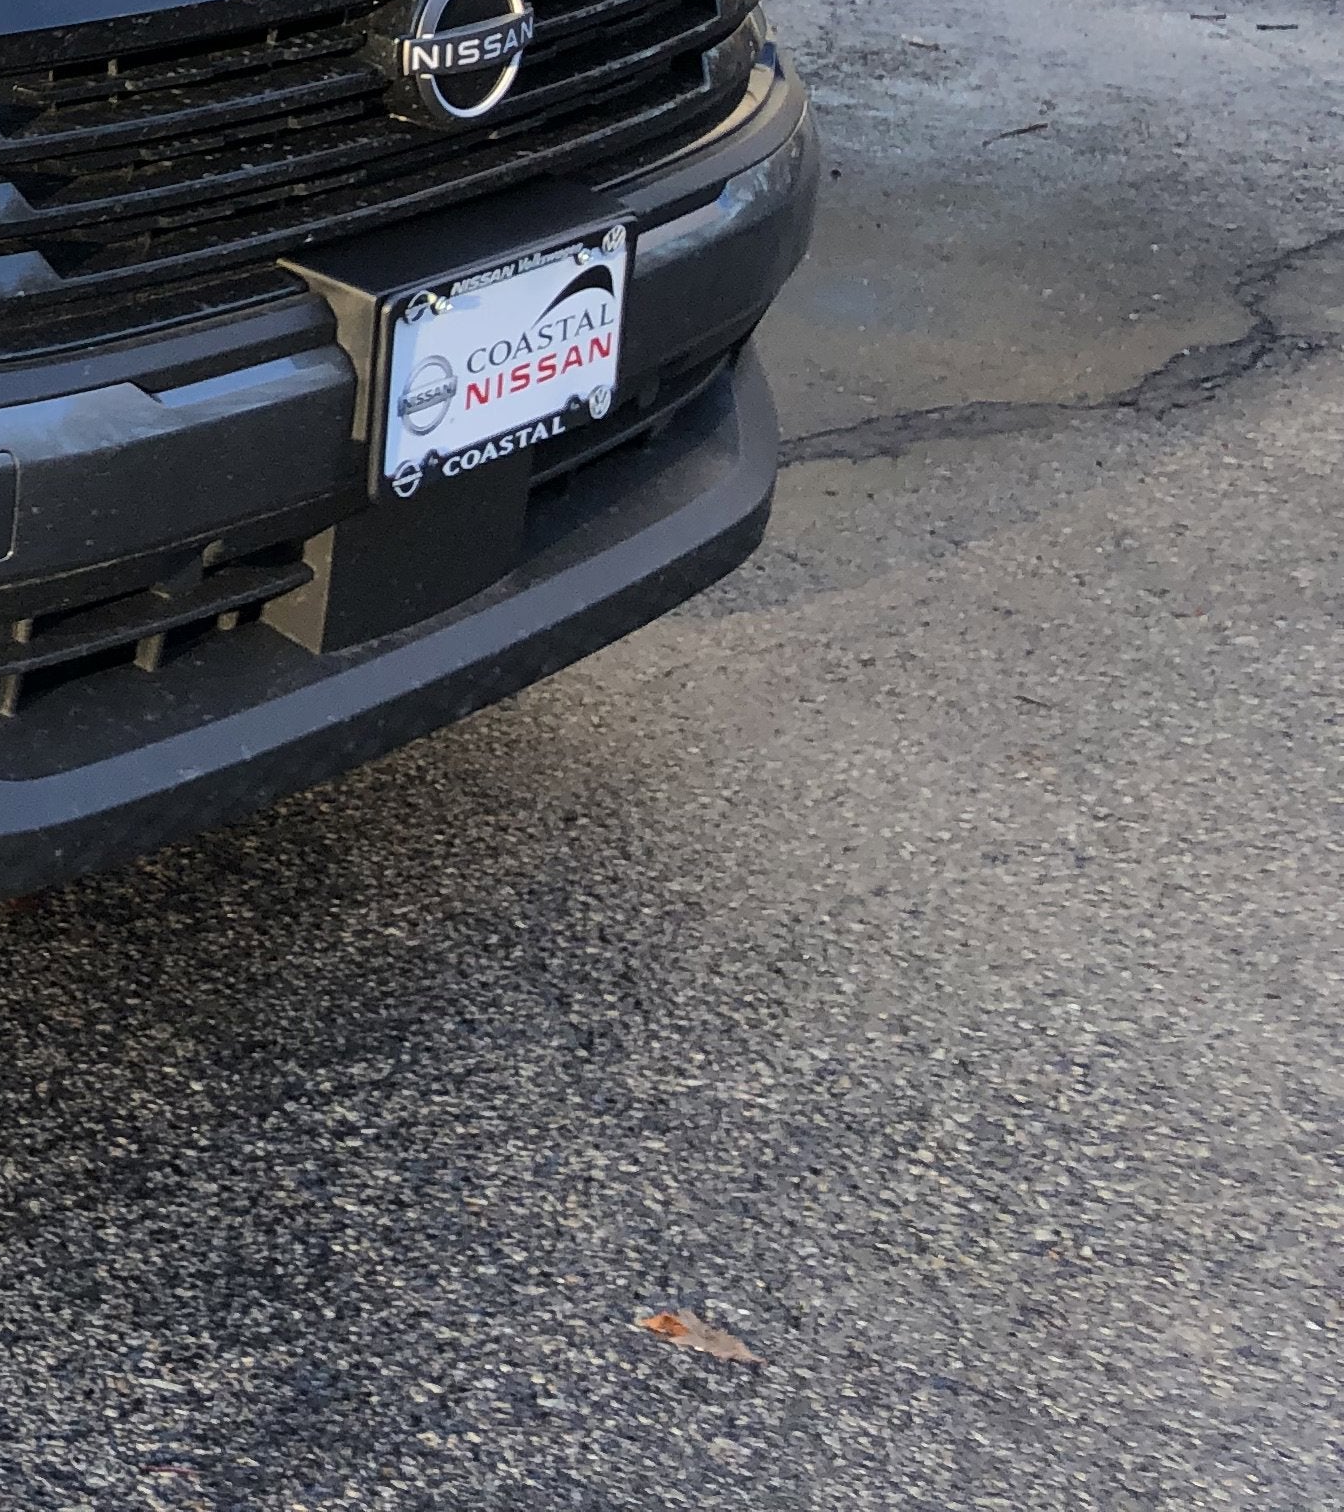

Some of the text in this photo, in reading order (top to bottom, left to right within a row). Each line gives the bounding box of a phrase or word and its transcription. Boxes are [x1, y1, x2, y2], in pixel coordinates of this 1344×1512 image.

[411, 16, 534, 71] NISSAN
[450, 264, 516, 296] NISSAN
[466, 303, 615, 374] COASTAL
[465, 332, 612, 410] NISSAN
[442, 416, 566, 477] COASTAL
